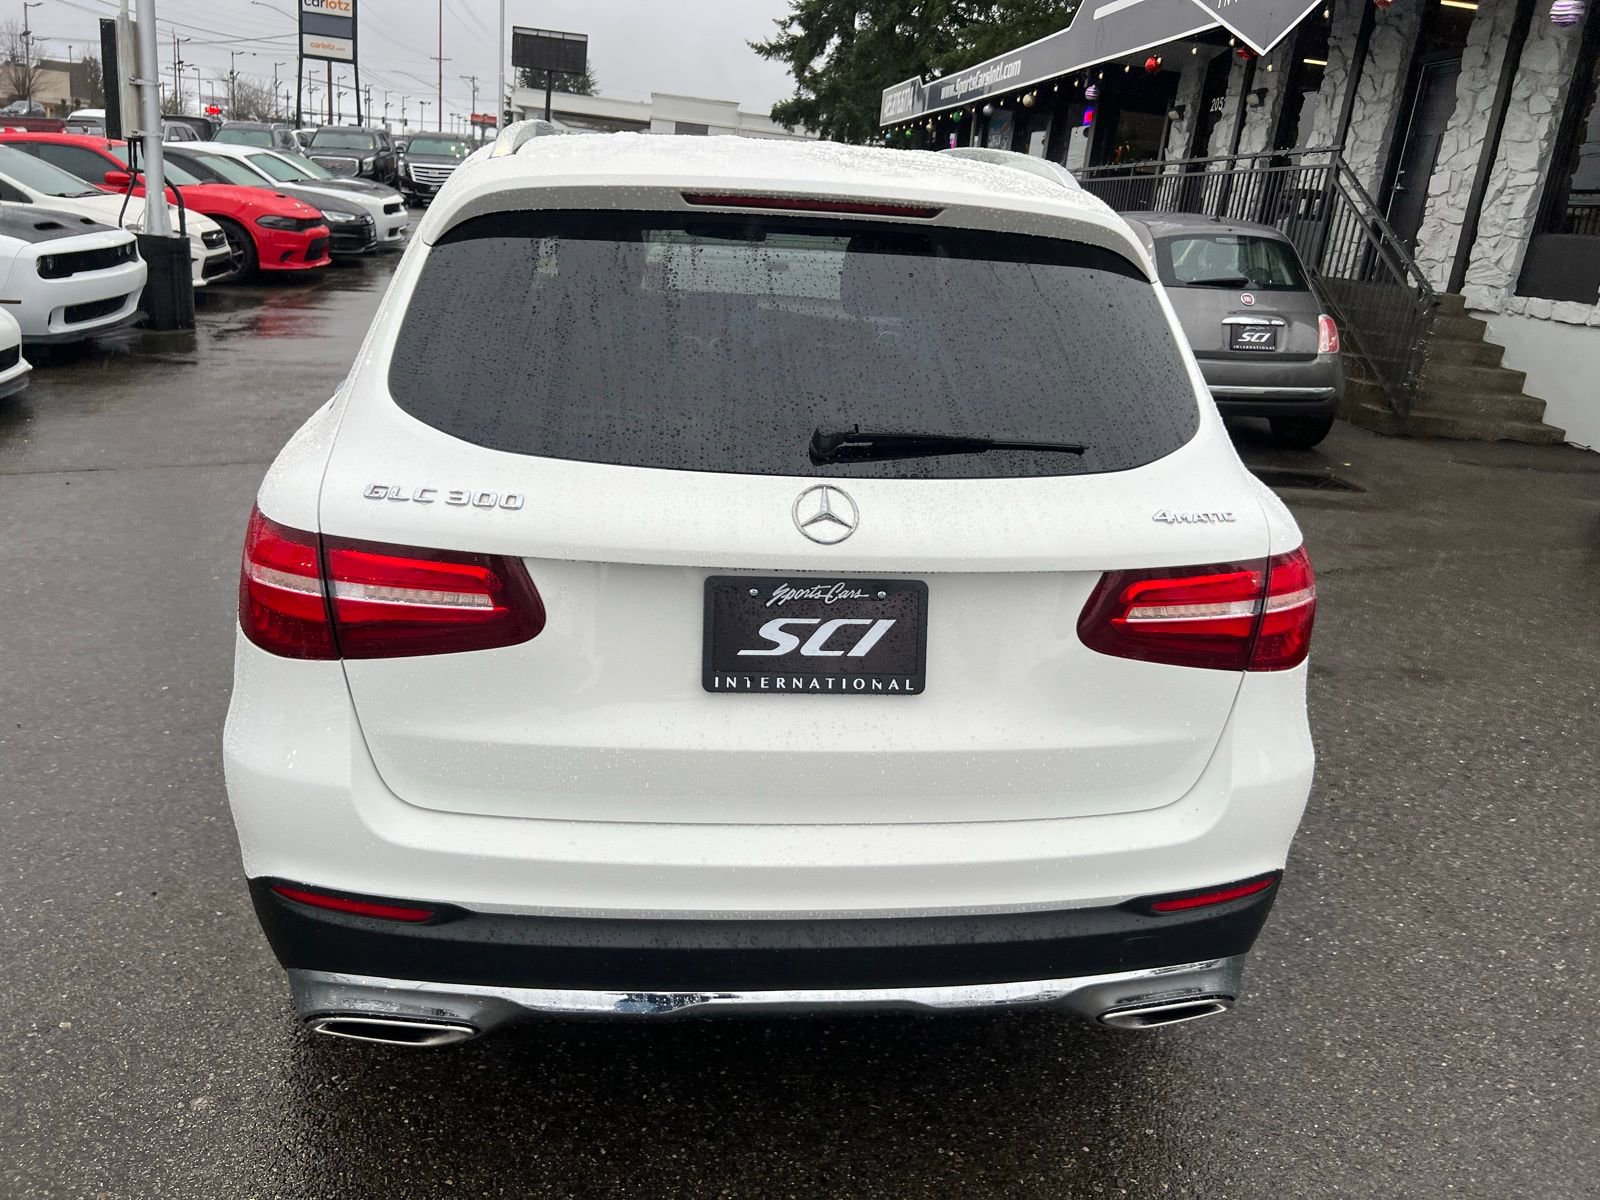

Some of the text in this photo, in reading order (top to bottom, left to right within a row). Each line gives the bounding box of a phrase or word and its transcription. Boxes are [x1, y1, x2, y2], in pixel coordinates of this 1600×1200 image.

[304, 0, 350, 11] carlotz
[1237, 332, 1271, 342] SCI
[363, 484, 525, 511] GLC 300
[1152, 509, 1236, 524] 4MATIC
[765, 581, 870, 608] Sports Cars
[736, 617, 897, 657] SCI
[713, 676, 915, 691] INTERNATIONAL
